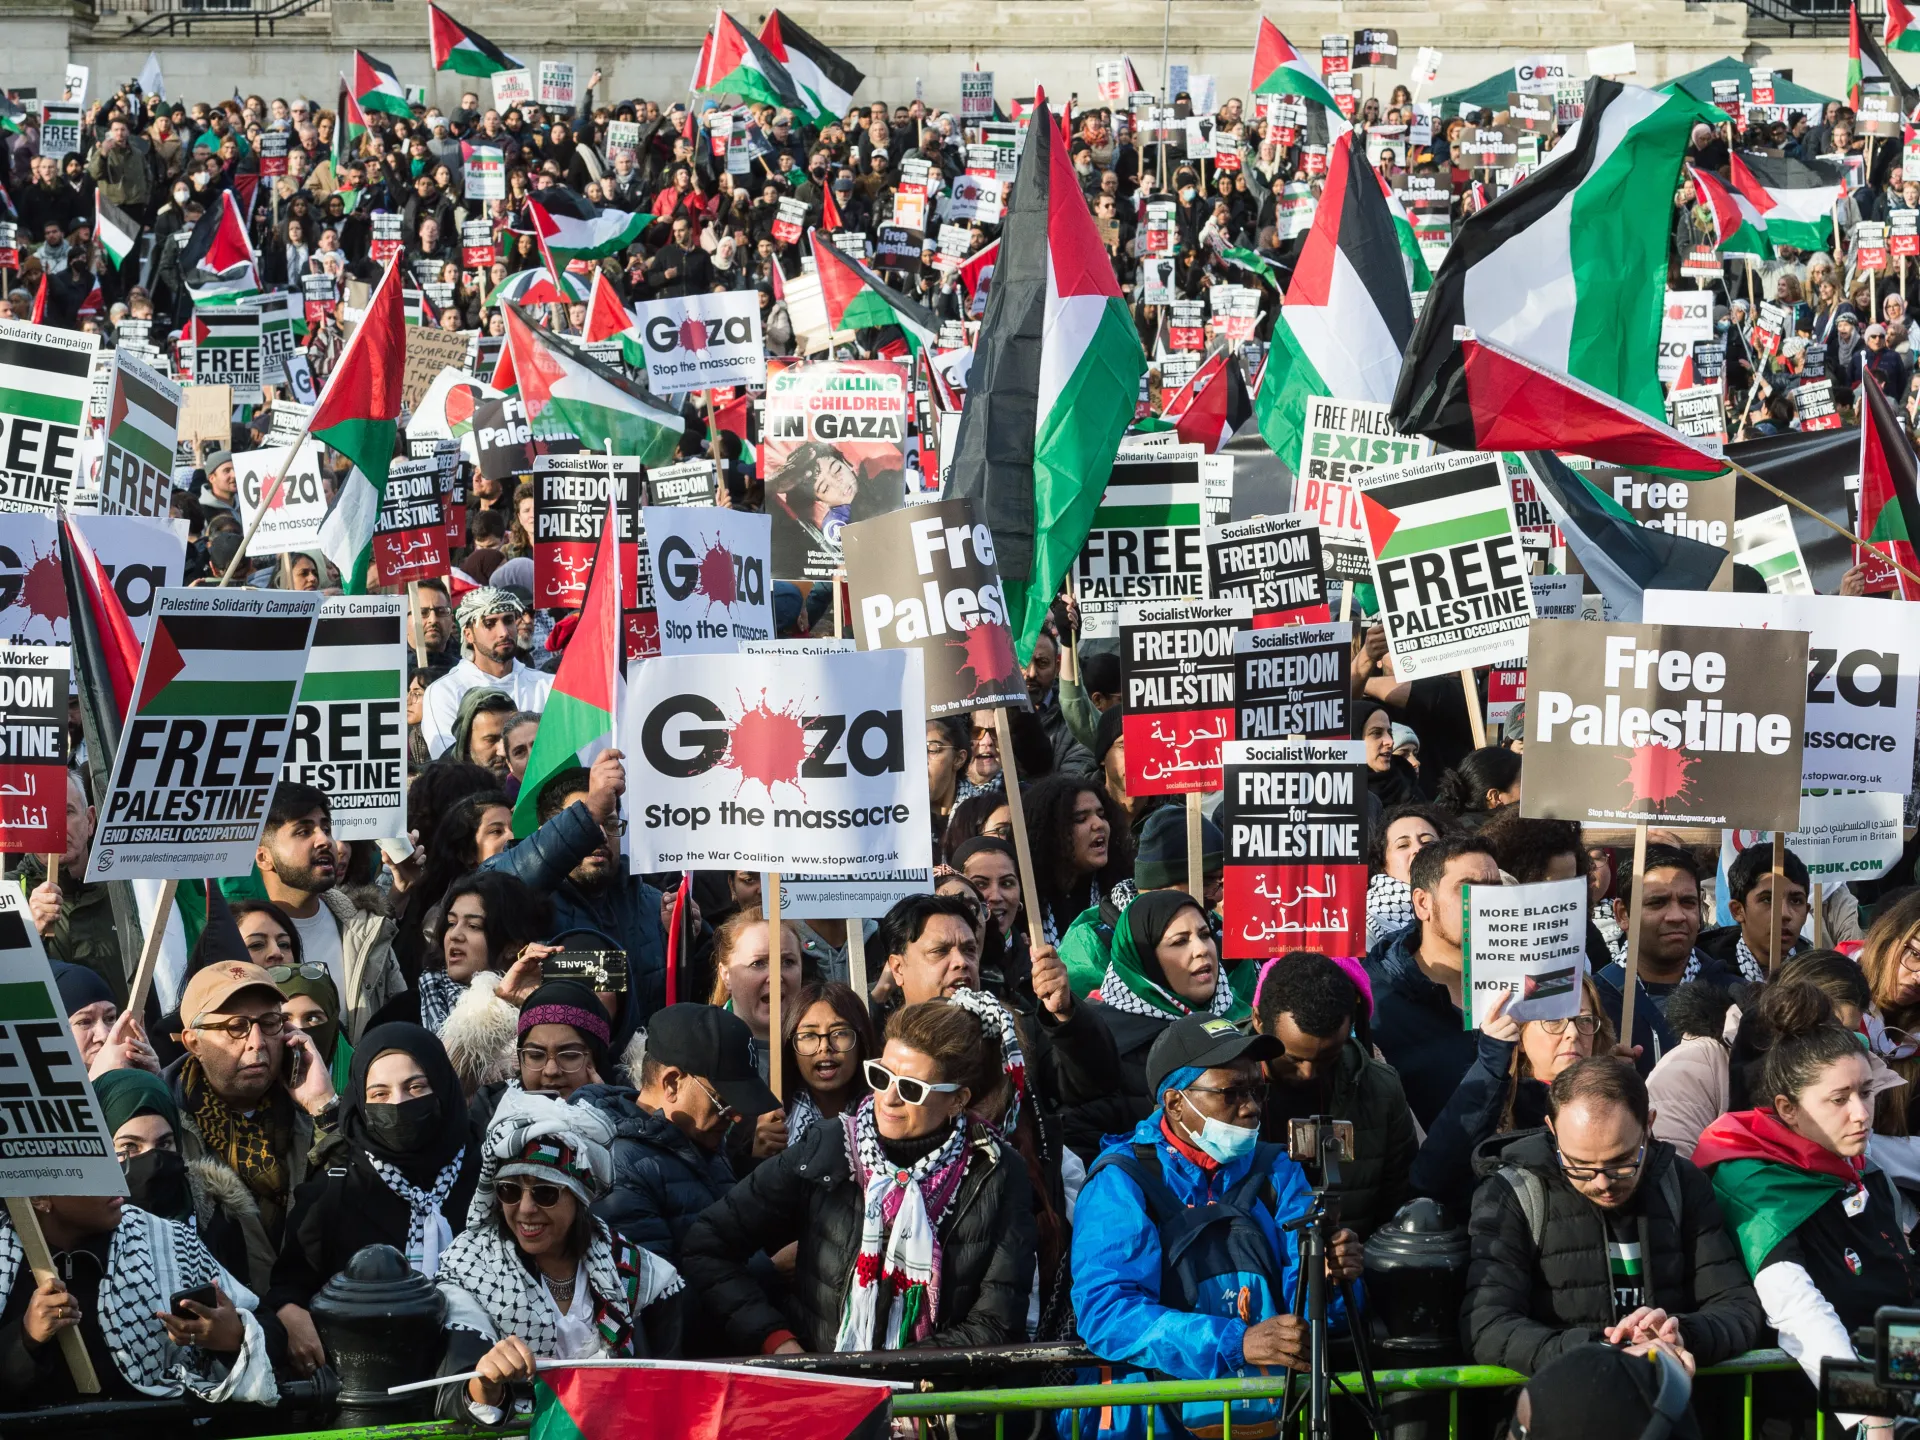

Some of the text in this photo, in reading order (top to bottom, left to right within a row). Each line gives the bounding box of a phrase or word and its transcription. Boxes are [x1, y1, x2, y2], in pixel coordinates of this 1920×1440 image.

[43, 126, 79, 140] FREE
[1476, 130, 1503, 141] Free
[1461, 142, 1517, 153] Palestine
[1408, 176, 1435, 188] Free
[955, 184, 996, 203] Gza
[884, 229, 908, 242] Free
[45, 332, 93, 350] Campaign
[262, 331, 293, 355] REE
[645, 316, 753, 352] Gza
[197, 350, 260, 372] FREE
[653, 356, 756, 378] Stop the massacre
[197, 373, 260, 385] PALESTINE
[826, 377, 899, 391] KILLING
[809, 396, 901, 411] CHILDREN
[1678, 397, 1719, 417] FREEDOM
[773, 414, 898, 439] IN GAZA
[1314, 404, 1348, 430] FREE
[1678, 417, 1723, 437] PALESTINE
[1157, 450, 1198, 463] Campaign
[1311, 432, 1420, 465] EXIST!
[102, 443, 170, 517] FREE
[1357, 451, 1495, 488] Palestine Solidarity Campaign
[243, 470, 319, 510] Gza
[543, 476, 628, 501] FREEDOM
[656, 476, 708, 499] FREEDOM
[1613, 476, 1689, 509] Free
[398, 499, 409, 508] for
[577, 501, 592, 513] for
[263, 521, 276, 533] the
[387, 533, 432, 554] الحرية
[1080, 528, 1202, 577] FREE
[386, 550, 441, 576] لفلسطين
[1218, 536, 1311, 574] FREEDOM
[658, 535, 764, 605] Gza
[1259, 568, 1276, 582] for
[1377, 536, 1525, 613] FREE
[1080, 575, 1202, 599] PALESTINE
[1220, 574, 1320, 611] PALESTINE
[161, 597, 316, 616] Palestine Solidarity Campaign
[349, 602, 401, 616] Campaign
[1082, 602, 1101, 612] END
[1388, 587, 1529, 638] PALESTINE
[666, 619, 691, 643] Stop
[696, 619, 727, 639] the
[733, 619, 768, 641] massacre
[1396, 616, 1530, 653] END ISRAELI OCCUPATION
[1132, 627, 1239, 661] FREEDOM
[1179, 659, 1197, 674] for
[1246, 651, 1340, 690] FREEDOM
[1604, 635, 1727, 693] Free
[1500, 672, 1525, 686] FOR A
[1129, 673, 1234, 708] PALESTIN
[1287, 687, 1304, 703] for
[931, 703, 947, 713] Stop
[948, 701, 959, 709] the
[960, 698, 974, 707] War
[976, 693, 1005, 705] Coalition
[1241, 698, 1345, 739] PALESTINE
[1536, 690, 1792, 755] Palestine
[290, 701, 401, 764] REE
[641, 693, 906, 778] Gza
[1150, 717, 1228, 748] الحرية
[116, 718, 287, 788] FREE
[1166, 779, 1218, 790] socialistworker.co.uk
[1238, 771, 1354, 805] FREEDOM
[106, 788, 270, 824] PALESTINE
[329, 794, 400, 809] OCCUPATION
[645, 801, 910, 830] Stop the massacre
[1289, 805, 1307, 822] for
[1588, 808, 1727, 825] Stop the War Coalition www.stopwar.org.uk
[103, 824, 257, 844] END ISRAELI OCCUPATION
[1232, 824, 1360, 858] PALESTINE
[1784, 831, 1897, 846] Palestinian Forum in Britain
[120, 850, 228, 867] www.palestinecampaign.org
[658, 850, 899, 866] Stop the War Coalition www.stopwar.org.uk
[1807, 859, 1883, 875] FBUK.COM
[796, 891, 906, 903] www.palestinecampaign.org
[1253, 873, 1337, 907] الحرية
[1479, 901, 1578, 918] MORE BLACKS
[1243, 907, 1349, 942] لفلسطين
[1488, 918, 1569, 933] MORE IRISH
[1488, 932, 1569, 948] MORE JEWS
[1475, 944, 1580, 962] MORE MUSLIMS
[555, 960, 594, 969] CHANEL
[1474, 980, 1519, 993] MORE
[6, 1137, 104, 1158] OCCUPATION
